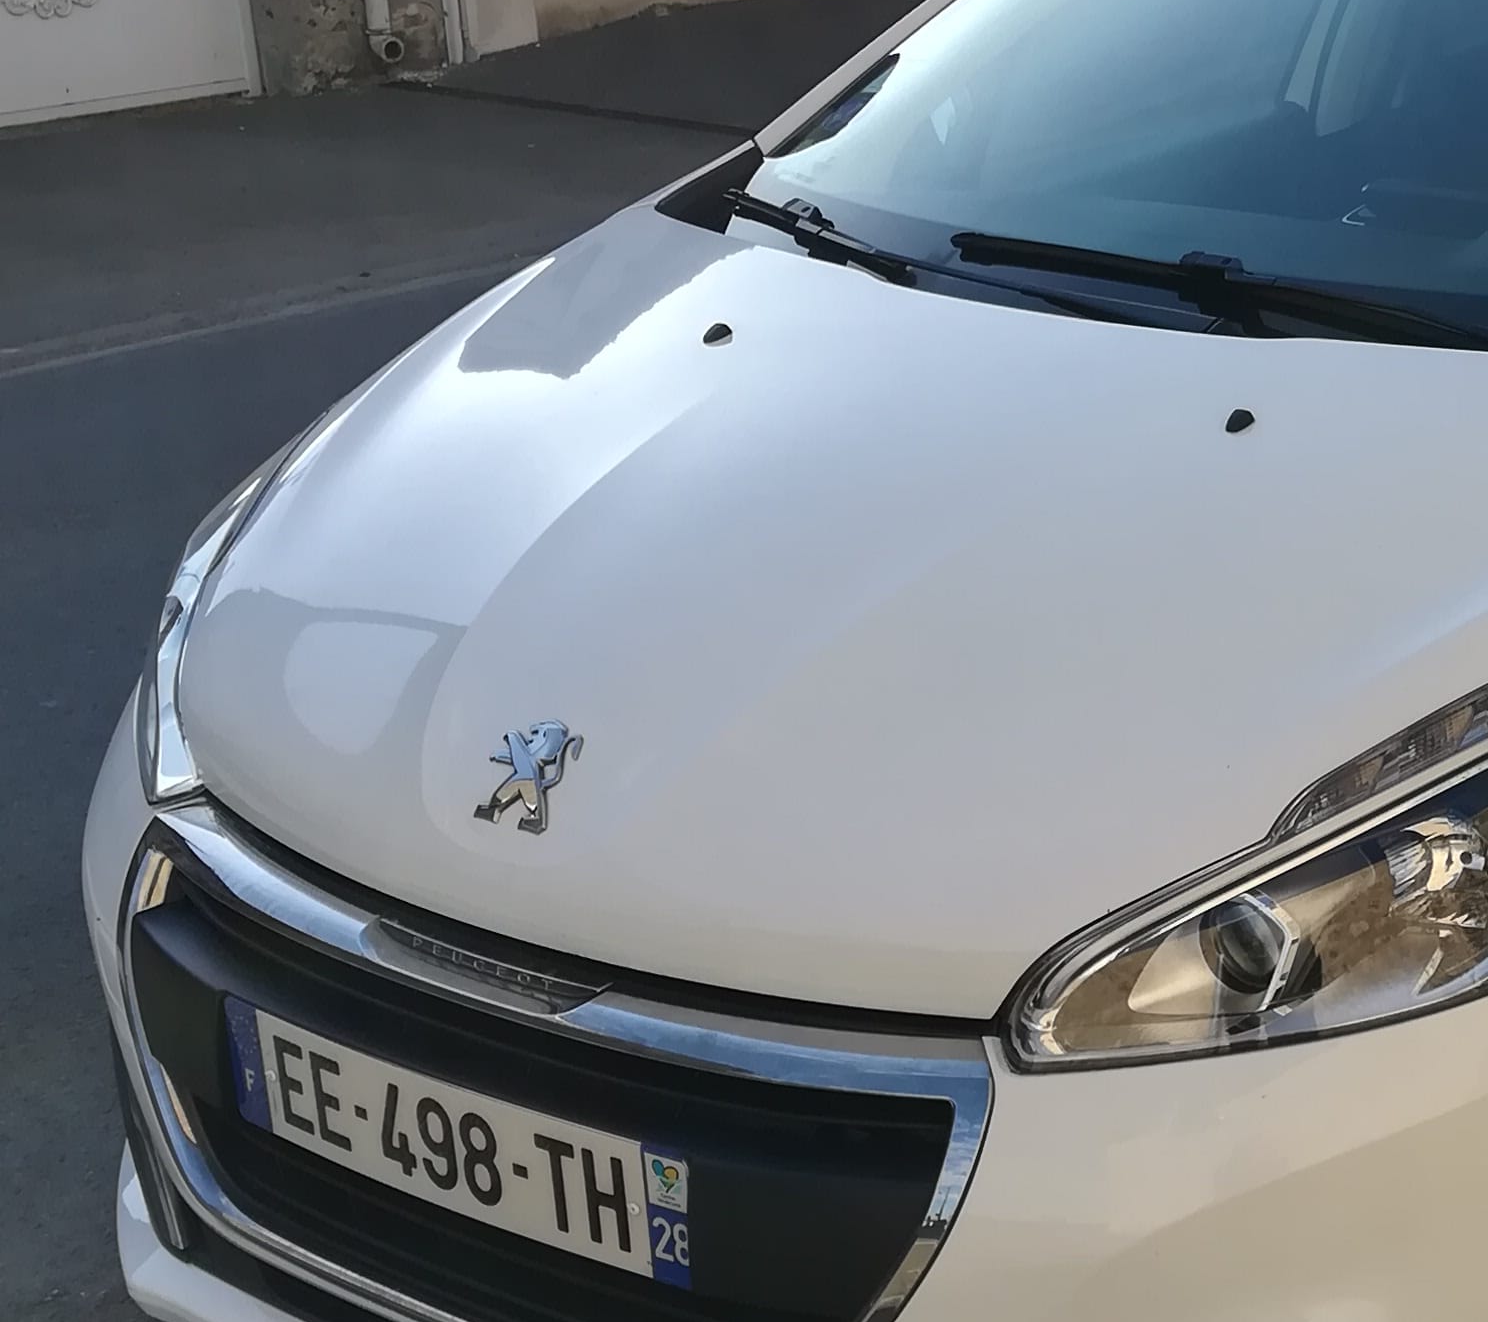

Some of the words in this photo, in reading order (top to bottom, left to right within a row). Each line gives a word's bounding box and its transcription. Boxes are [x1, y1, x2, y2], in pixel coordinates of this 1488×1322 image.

[411, 934, 554, 992] PEUGEOT
[243, 1068, 256, 1092] F
[273, 1034, 632, 1254] EE-498-TH
[652, 1216, 690, 1268] 28
